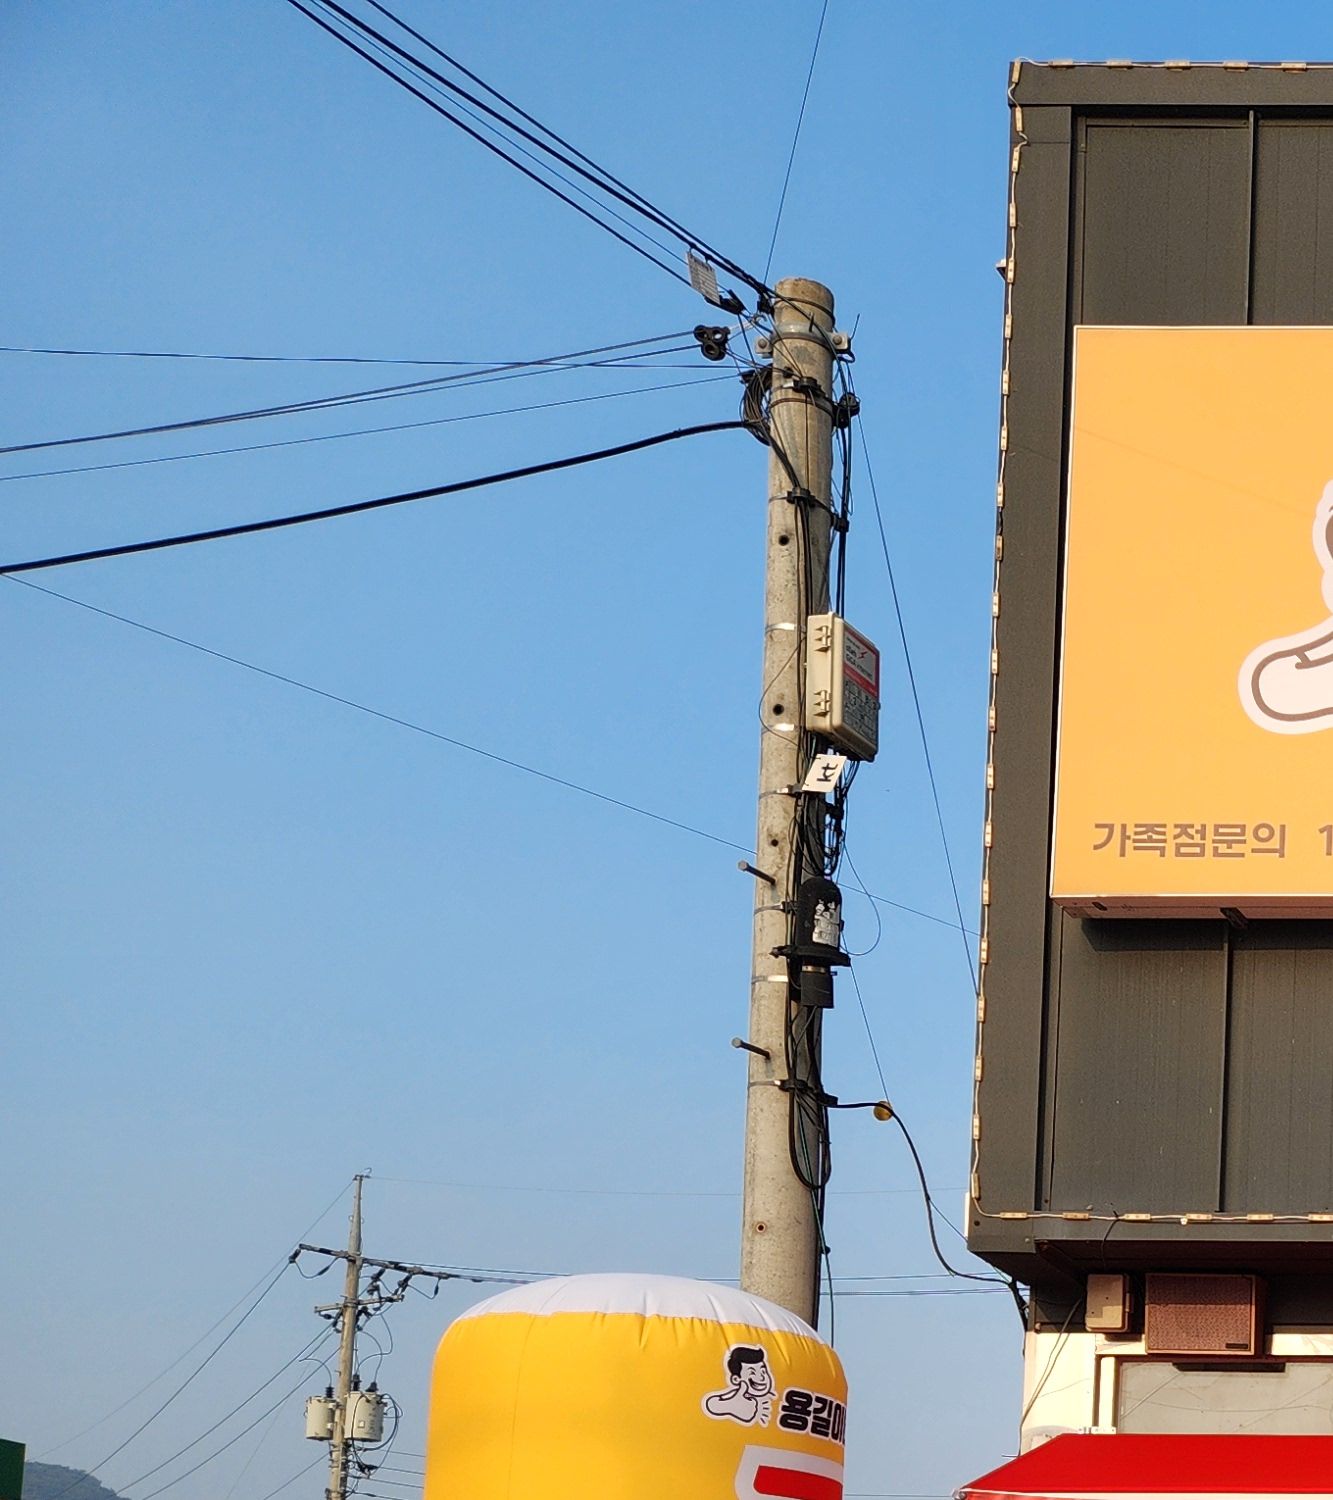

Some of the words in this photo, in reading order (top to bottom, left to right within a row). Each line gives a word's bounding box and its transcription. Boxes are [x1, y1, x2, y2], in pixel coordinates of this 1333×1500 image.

[816, 763, 839, 783] kt
[1091, 820, 1288, 860] 가족점문의
[779, 1389, 847, 1447] 용길이
